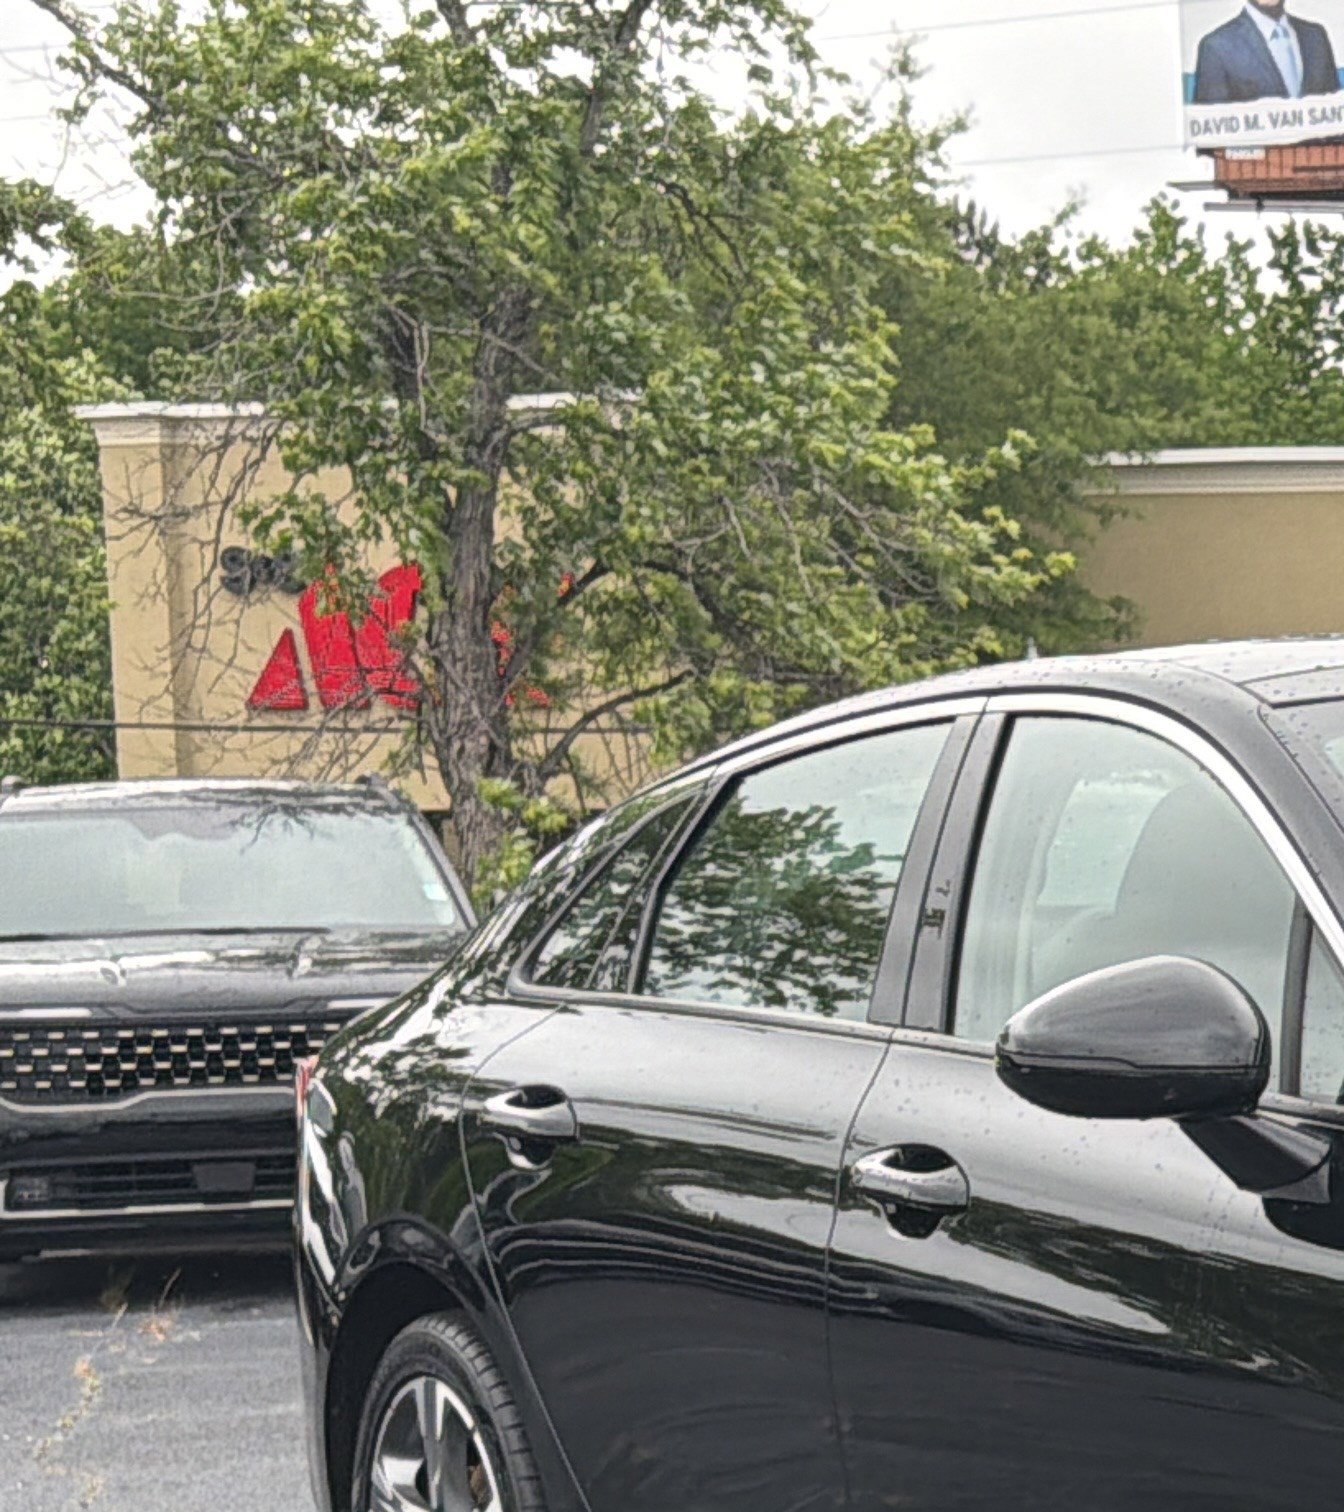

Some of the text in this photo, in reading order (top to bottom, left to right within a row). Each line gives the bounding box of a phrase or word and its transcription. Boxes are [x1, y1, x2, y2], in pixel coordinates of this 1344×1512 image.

[1190, 115, 1240, 137] DAVID
[1243, 113, 1265, 132] M.
[1267, 109, 1303, 129] VAN
